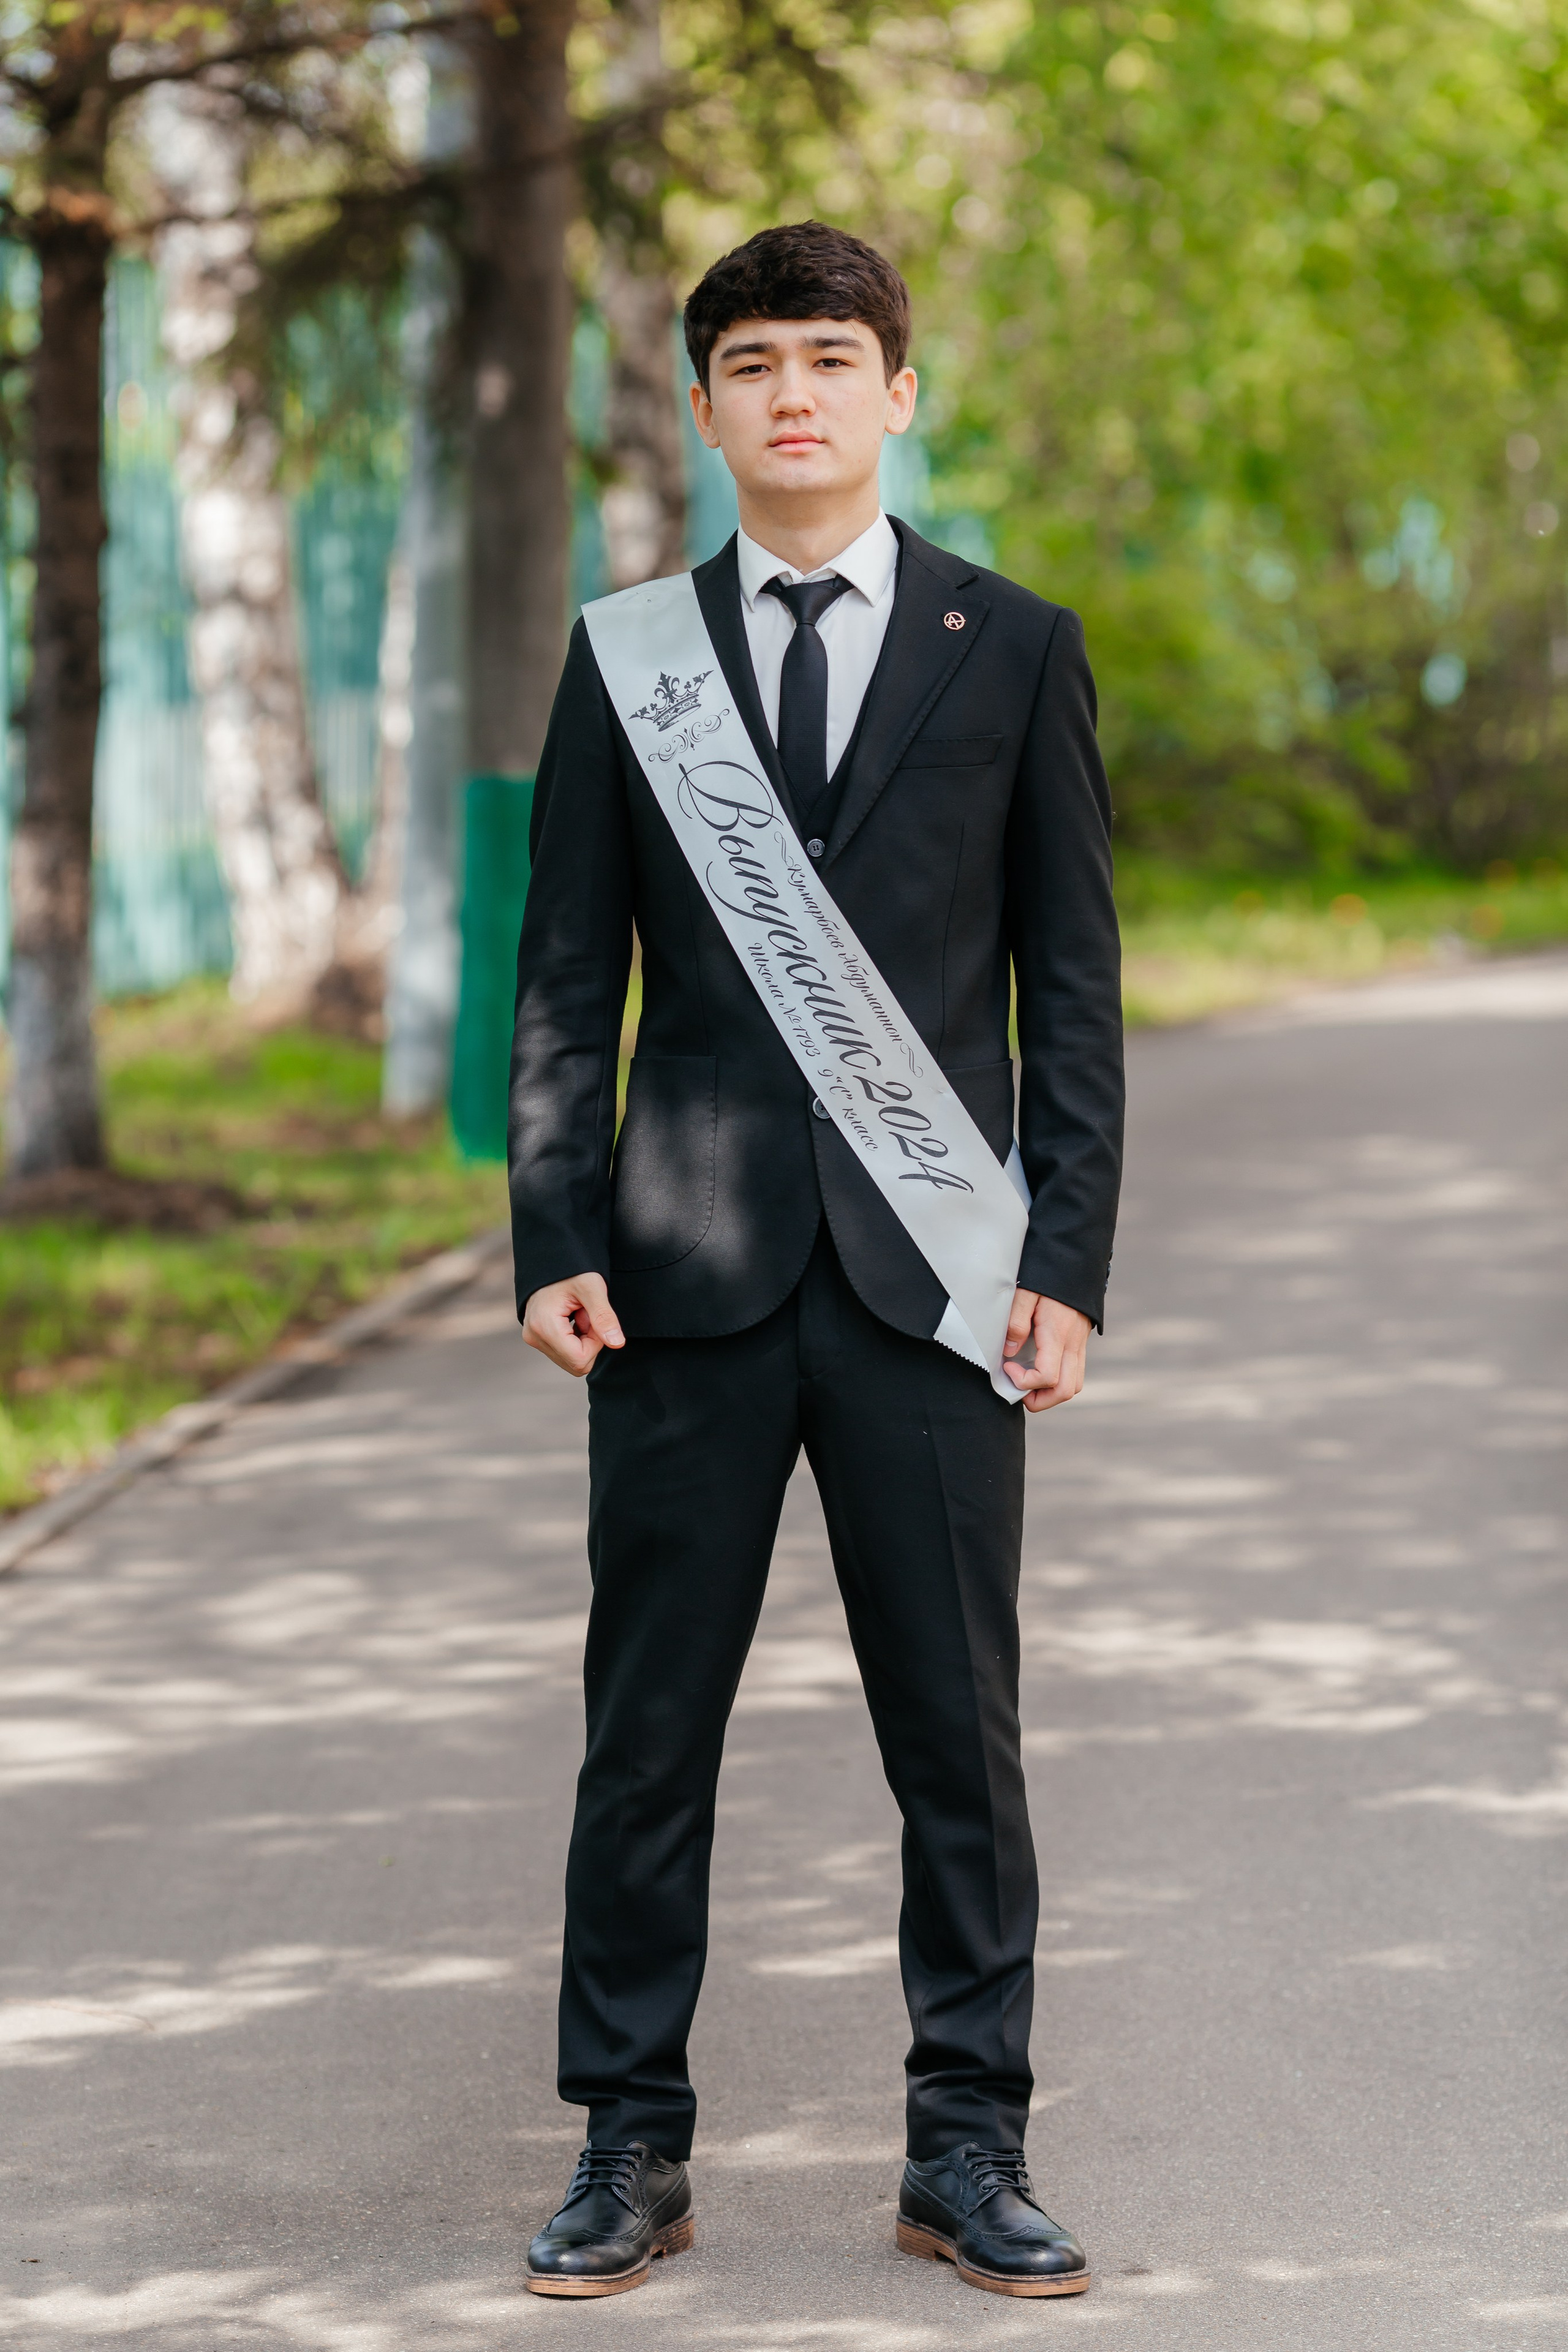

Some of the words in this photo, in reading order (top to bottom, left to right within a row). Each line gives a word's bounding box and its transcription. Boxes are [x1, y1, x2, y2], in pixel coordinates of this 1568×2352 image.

[676, 760, 881, 1070] Выпускник
[851, 1074, 974, 1194] 2024
[747, 941, 784, 998] Школа
[841, 1107, 878, 1149] класс
[786, 863, 845, 948] Кумарбоев
[837, 952, 902, 1042] Абдуманнон
